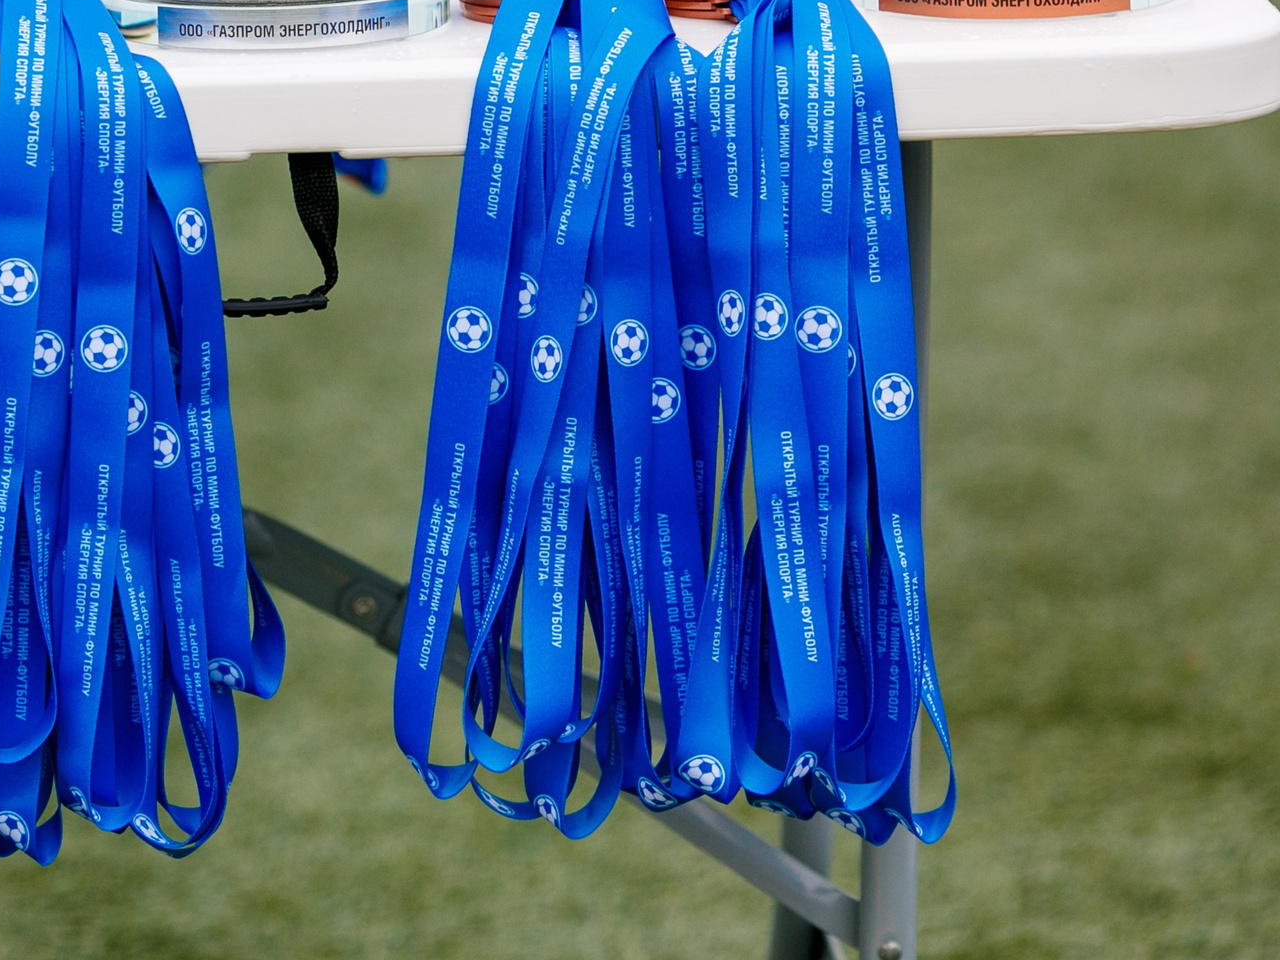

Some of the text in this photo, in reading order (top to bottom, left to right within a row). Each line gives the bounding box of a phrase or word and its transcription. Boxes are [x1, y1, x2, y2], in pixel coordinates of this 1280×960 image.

[14, 16, 30, 105] «ЭНЕРГИЯ СПОРТА»
[32, 58, 44, 71] ПО
[34, 24, 46, 56] ТУРНИР
[179, 16, 391, 38] ООО «ГАЗПРОМ ЭНЕРГОХОЛДИНГ»
[26, 75, 43, 167] МИНИ-ФУТБОЛУ
[96, 65, 111, 173] «ЭНЕРГИЯ СПОРТА»
[98, 32, 126, 234] ОТКРЫТЫЙ ТУРНИР ПО МИНИ-ФУТБОЛУ
[480, 52, 508, 155] «ЭНЕРГИЯ СПОРТА»
[487, 12, 540, 219] ОТКРЫТЫЙ ТУРНИР ПО МИНИ-ФУТБОЛУ
[807, 45, 819, 153] «ЭНЕРГИЯ СПОРТА»
[818, 2, 836, 214] ОТКРЫТЫЙ ТУРНИР ПО МИНИ-ФУТБОЛУ
[201, 341, 224, 567] ОТКРЫТЫЙ ТУРНИР ПО МИНИ-ФУТБОЛУ
[75, 523, 92, 635] «ЭНЕРГИЯ СПОРТА»
[82, 464, 109, 696] ОТКРЫТЫЙ ТУРНИР ПО МИНИ-ФУТБОЛУ
[419, 443, 465, 670] ОТКРЫТЫЙ ТУРНИР ПО МИНИ-ФУТБОЛУ
[538, 477, 555, 585] «ЭНЕРГИЯ СПОРТА»
[552, 417, 577, 648] ОТКРЫТЫЙ ТУРНИР ПО МИНИ-ФУТБОЛУ
[771, 494, 793, 603] «ЭНЕРГИЯ СПОРТА»
[781, 431, 817, 662] ОТКРЫТЫЙ ТУРНИР ПО МИНИ-ФУТБОЛУ
